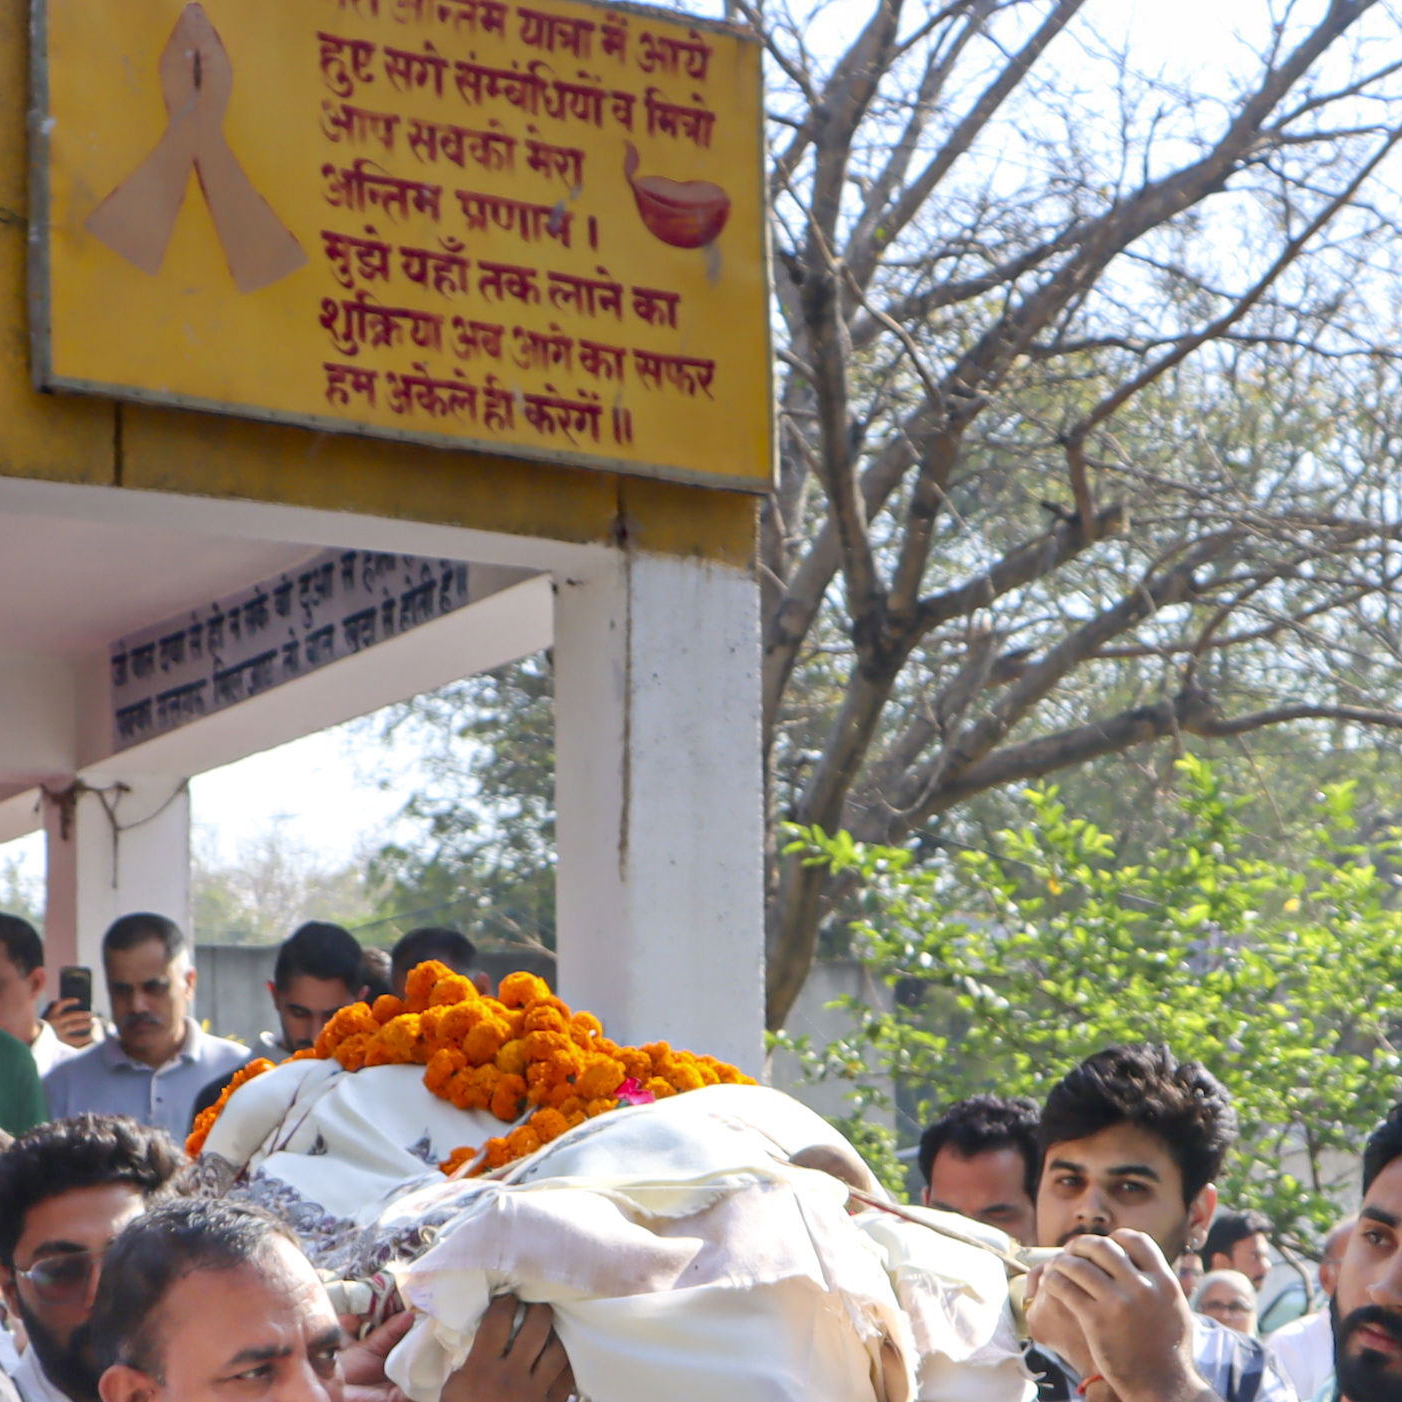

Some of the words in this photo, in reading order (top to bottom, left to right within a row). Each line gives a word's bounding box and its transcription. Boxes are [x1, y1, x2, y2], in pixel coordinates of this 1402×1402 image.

[317, 31, 376, 98] हुए
[384, 40, 449, 98] सगे
[517, 7, 595, 59] यात्रा
[601, 12, 628, 65] में
[637, 29, 713, 82] आये
[319, 100, 401, 151] आप
[524, 124, 586, 192] मेरा
[321, 158, 443, 225] अन्तिम
[454, 189, 575, 249] प्रणाम
[320, 224, 392, 289] मुझे
[399, 236, 470, 299] यहाँ
[477, 260, 542, 304] तक
[547, 265, 624, 321] लाने
[631, 286, 681, 330] का
[319, 290, 444, 356] शुक्रिया
[511, 322, 574, 374] आगे
[579, 339, 627, 384] का
[633, 348, 715, 401] सफर
[322, 361, 377, 406] हम
[386, 361, 478, 422] अकेले
[483, 373, 515, 431] ही
